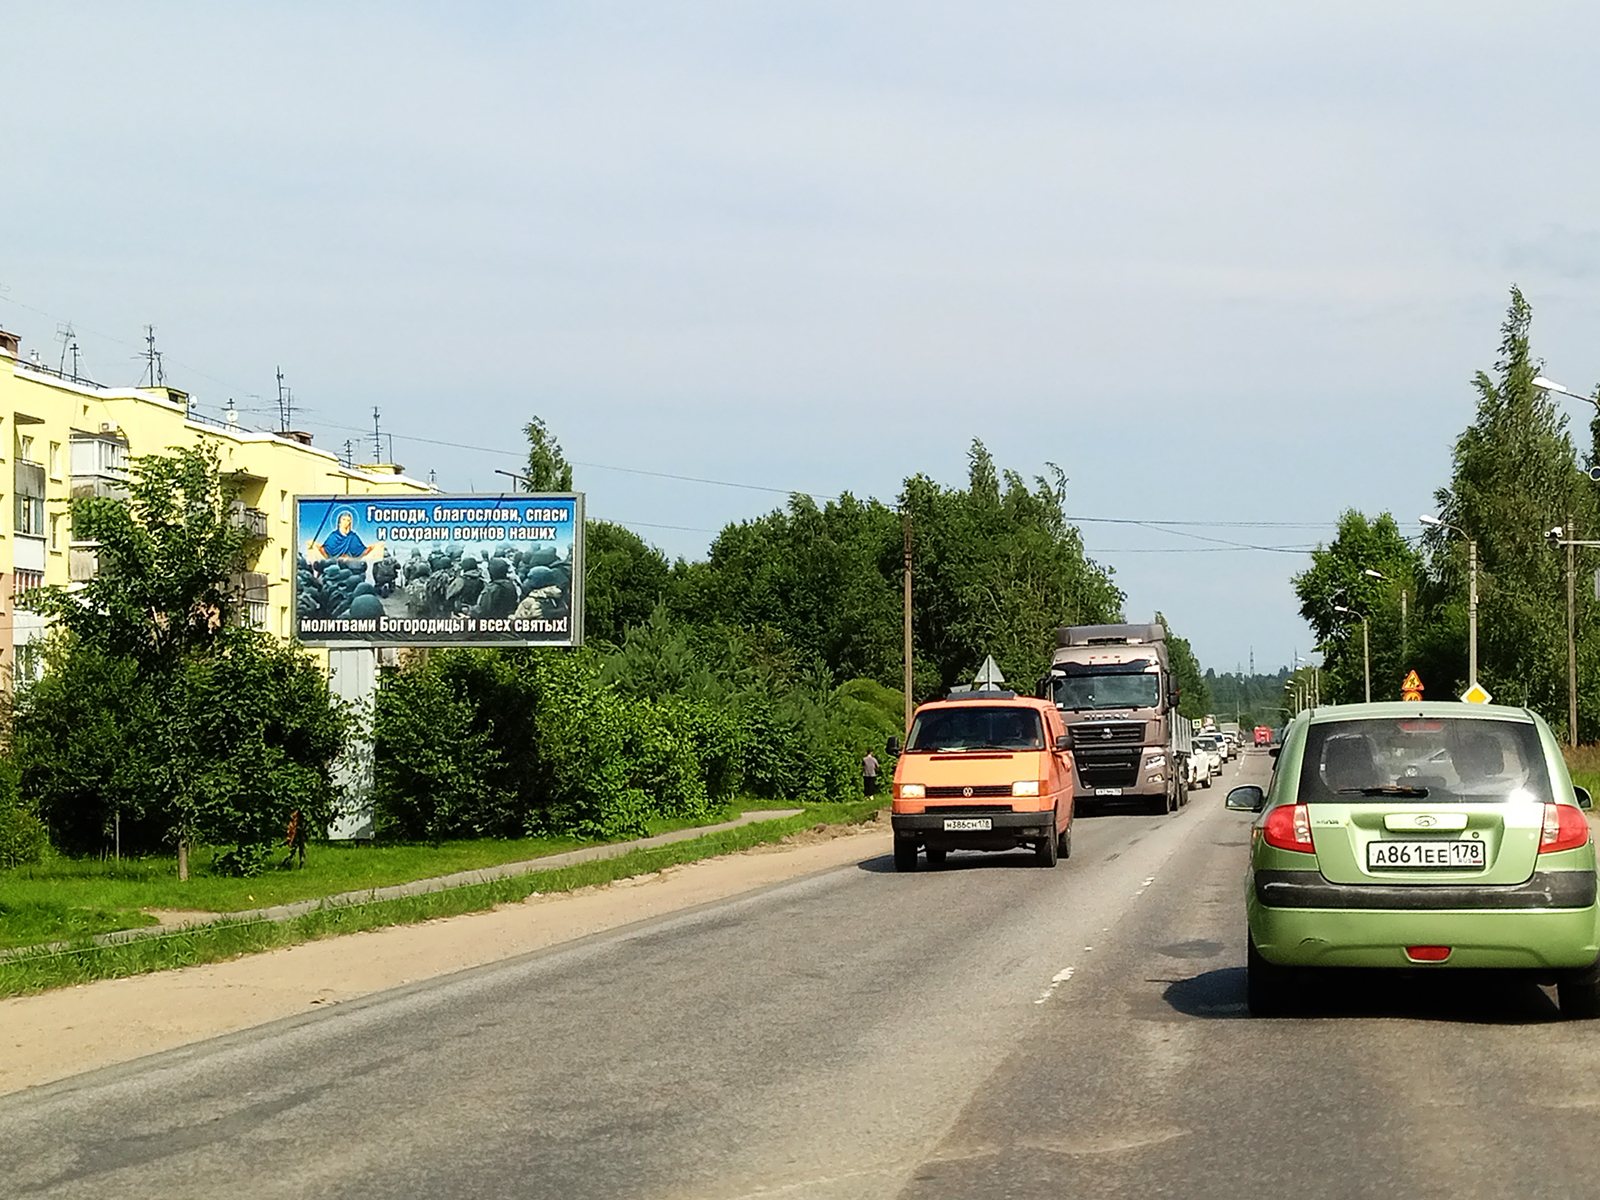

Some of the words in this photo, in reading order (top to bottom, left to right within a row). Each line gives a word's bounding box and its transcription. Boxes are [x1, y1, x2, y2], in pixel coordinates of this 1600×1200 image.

[367, 506, 430, 524] Господи,
[434, 506, 522, 524] благослови,
[526, 508, 568, 522] спаси
[378, 527, 387, 540] и
[391, 527, 449, 543] сохрани
[454, 527, 505, 541] воинов
[509, 527, 556, 540] наших
[301, 619, 376, 632] молитвами
[379, 616, 464, 634] Богородицы
[468, 618, 476, 632] и
[480, 618, 510, 632] всех
[515, 617, 568, 632] святых!
[1376, 846, 1448, 863] А861ЕЕ
[1452, 845, 1479, 858] 178
